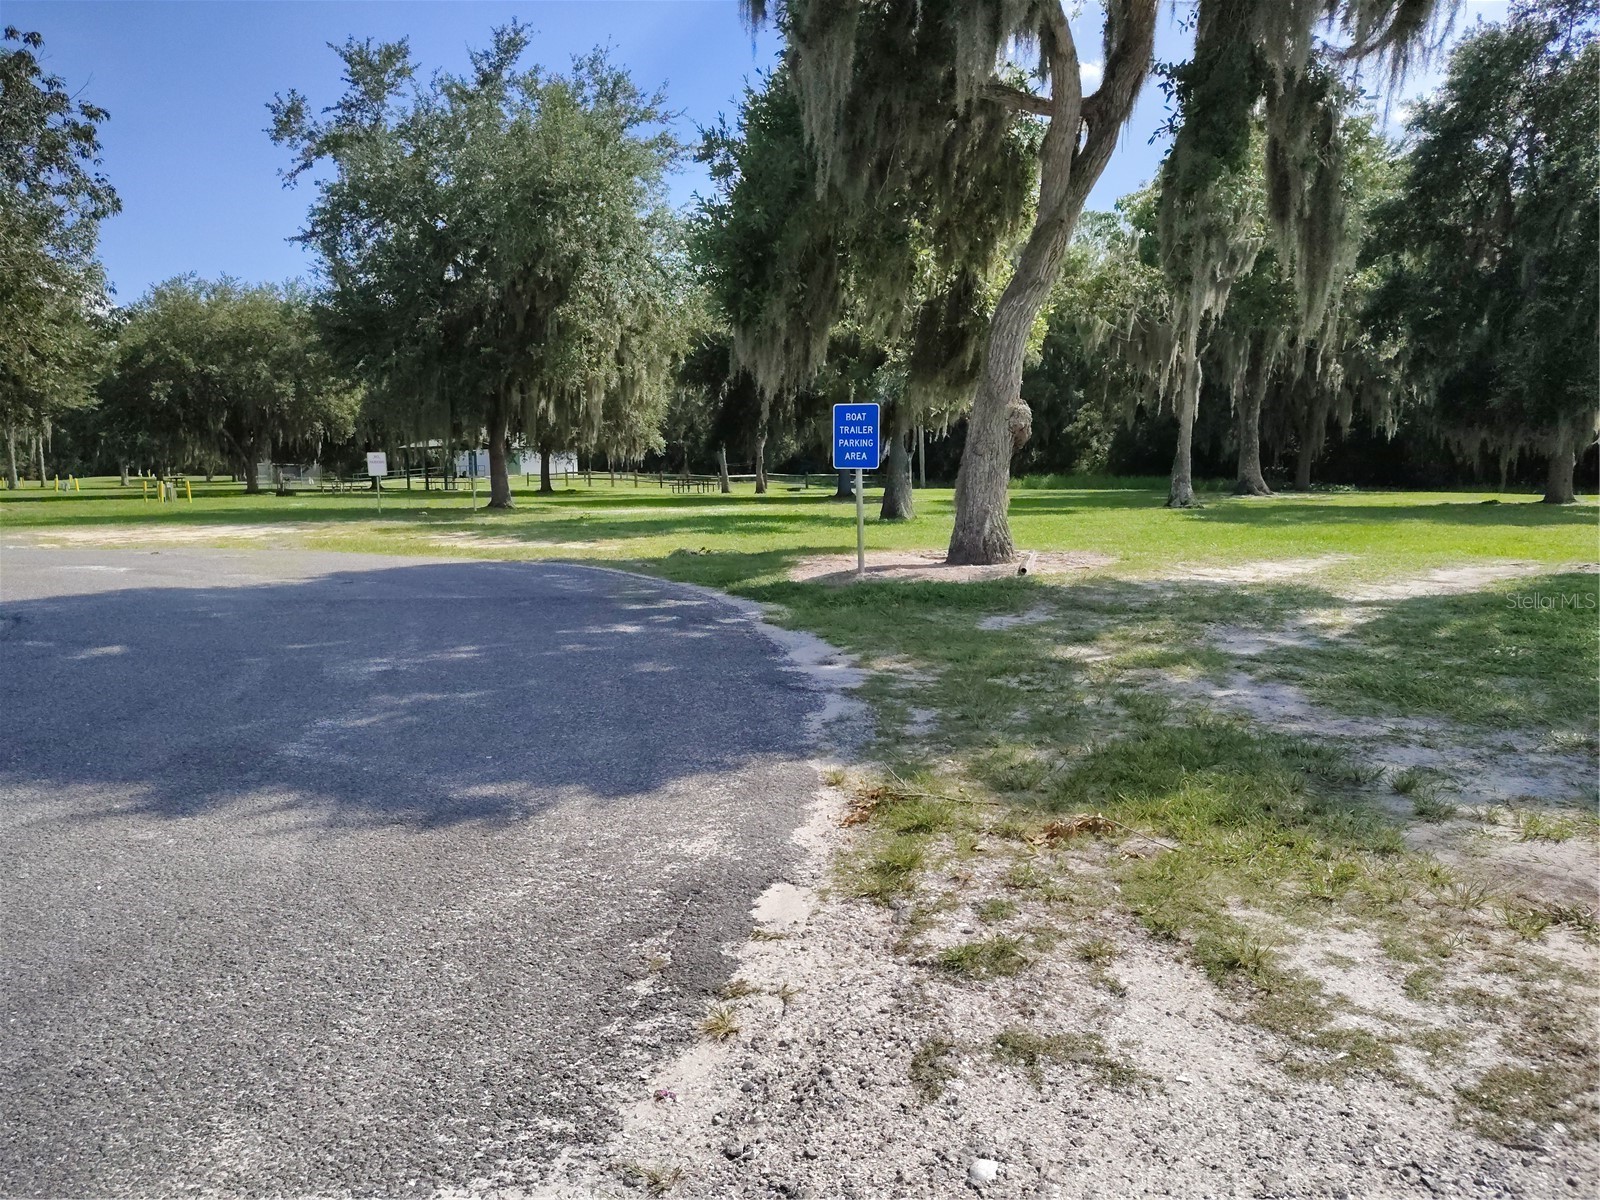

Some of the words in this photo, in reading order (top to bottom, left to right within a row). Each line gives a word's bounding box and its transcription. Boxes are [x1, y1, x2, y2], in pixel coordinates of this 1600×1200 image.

[845, 412, 867, 421] BOAT
[840, 426, 873, 434] TRAILER
[839, 439, 873, 447] PARKING
[845, 452, 867, 460] AREA
